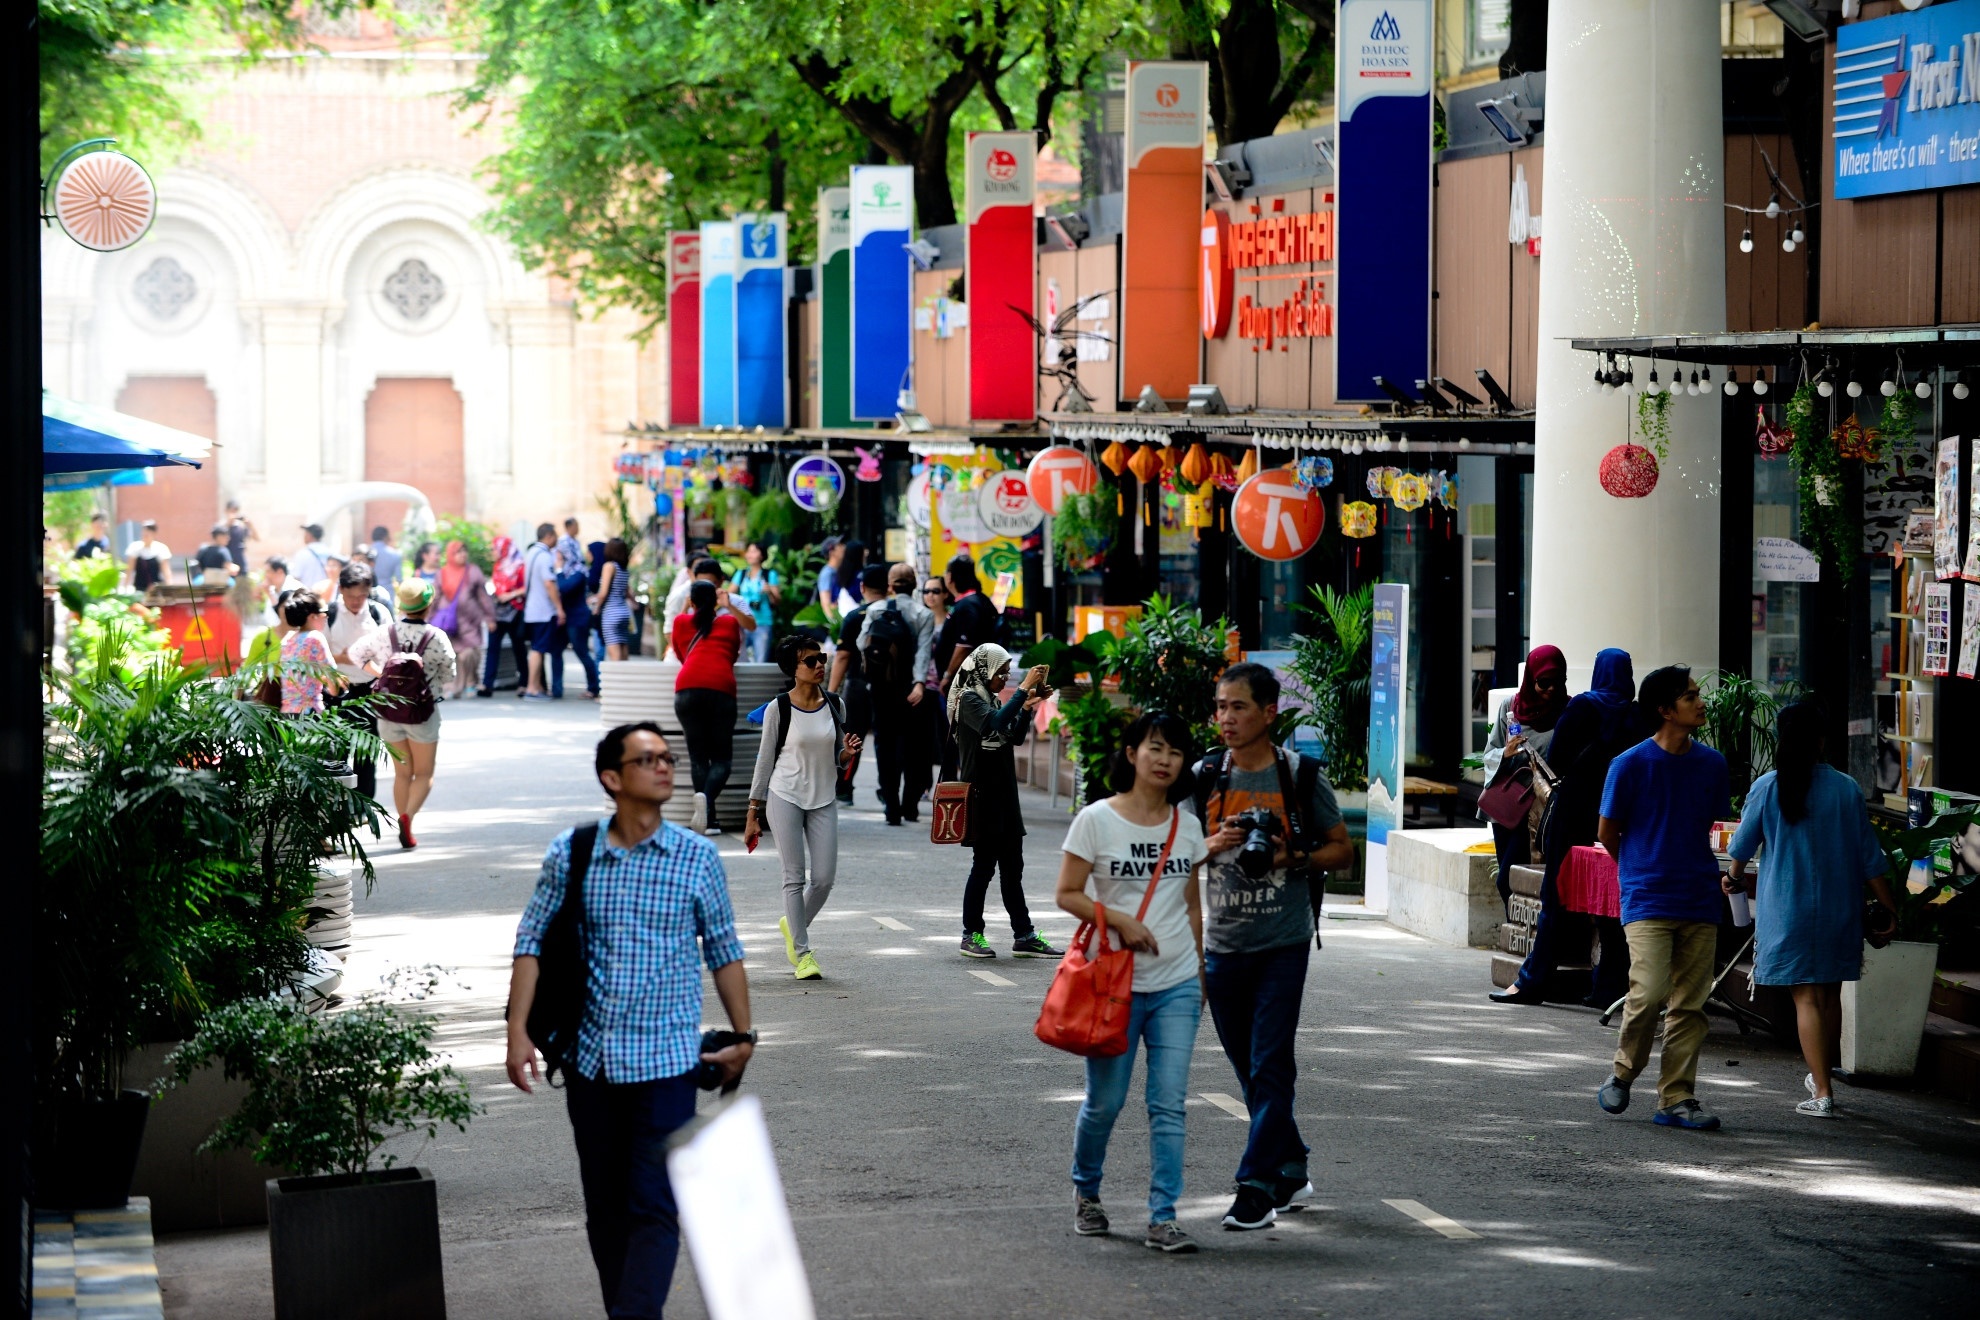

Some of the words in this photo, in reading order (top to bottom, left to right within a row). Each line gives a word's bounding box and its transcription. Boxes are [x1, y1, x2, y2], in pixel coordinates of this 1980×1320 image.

[1906, 43, 1961, 113] First
[1839, 146, 1870, 177] Where
[1872, 139, 1906, 173] there's
[1908, 152, 1915, 168] a
[1918, 134, 1938, 166] will
[1210, 887, 1276, 908] WANDER
[1241, 906, 1258, 914] ARE
[1261, 906, 1283, 914] LOST
